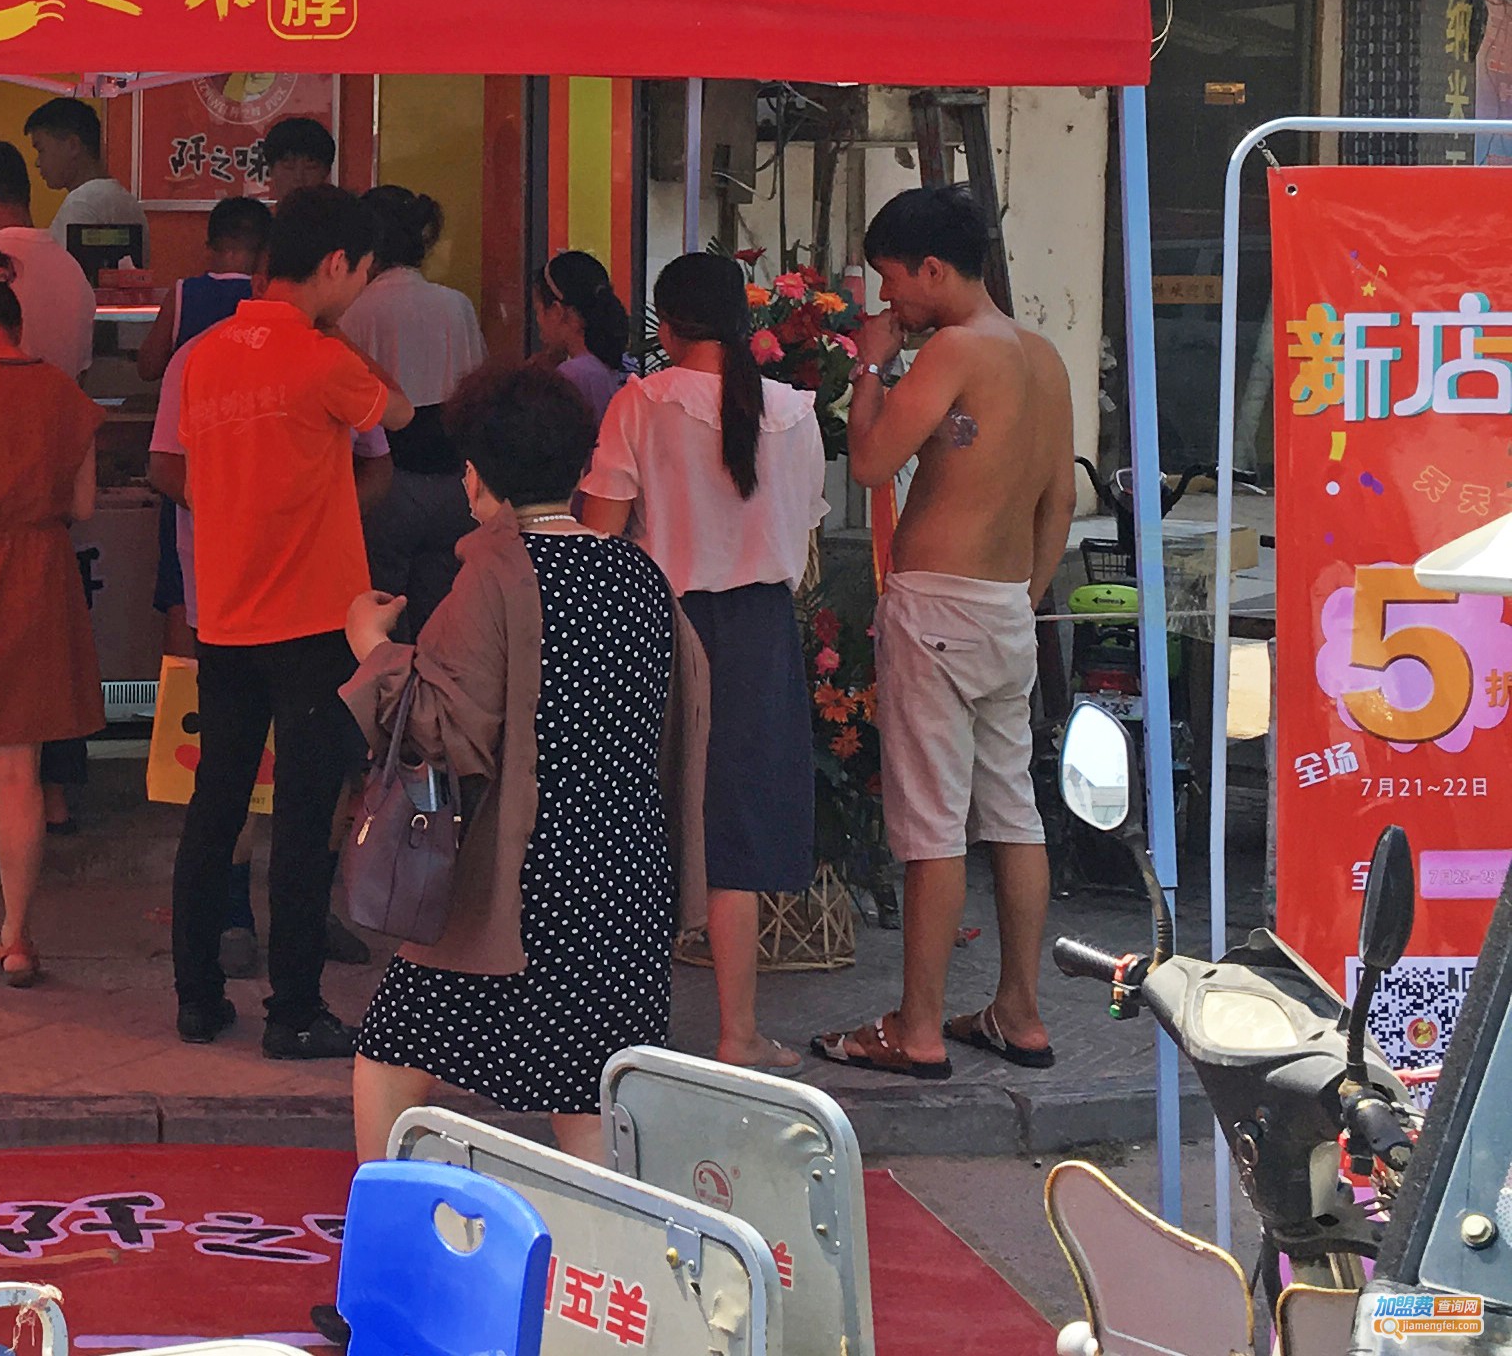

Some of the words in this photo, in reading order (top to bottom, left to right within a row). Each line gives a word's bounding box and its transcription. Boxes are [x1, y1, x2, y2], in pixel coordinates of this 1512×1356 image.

[1294, 741, 1359, 788] 全场
[1360, 777, 1488, 798] 7月21~22日
[543, 1254, 651, 1347] 五羊
